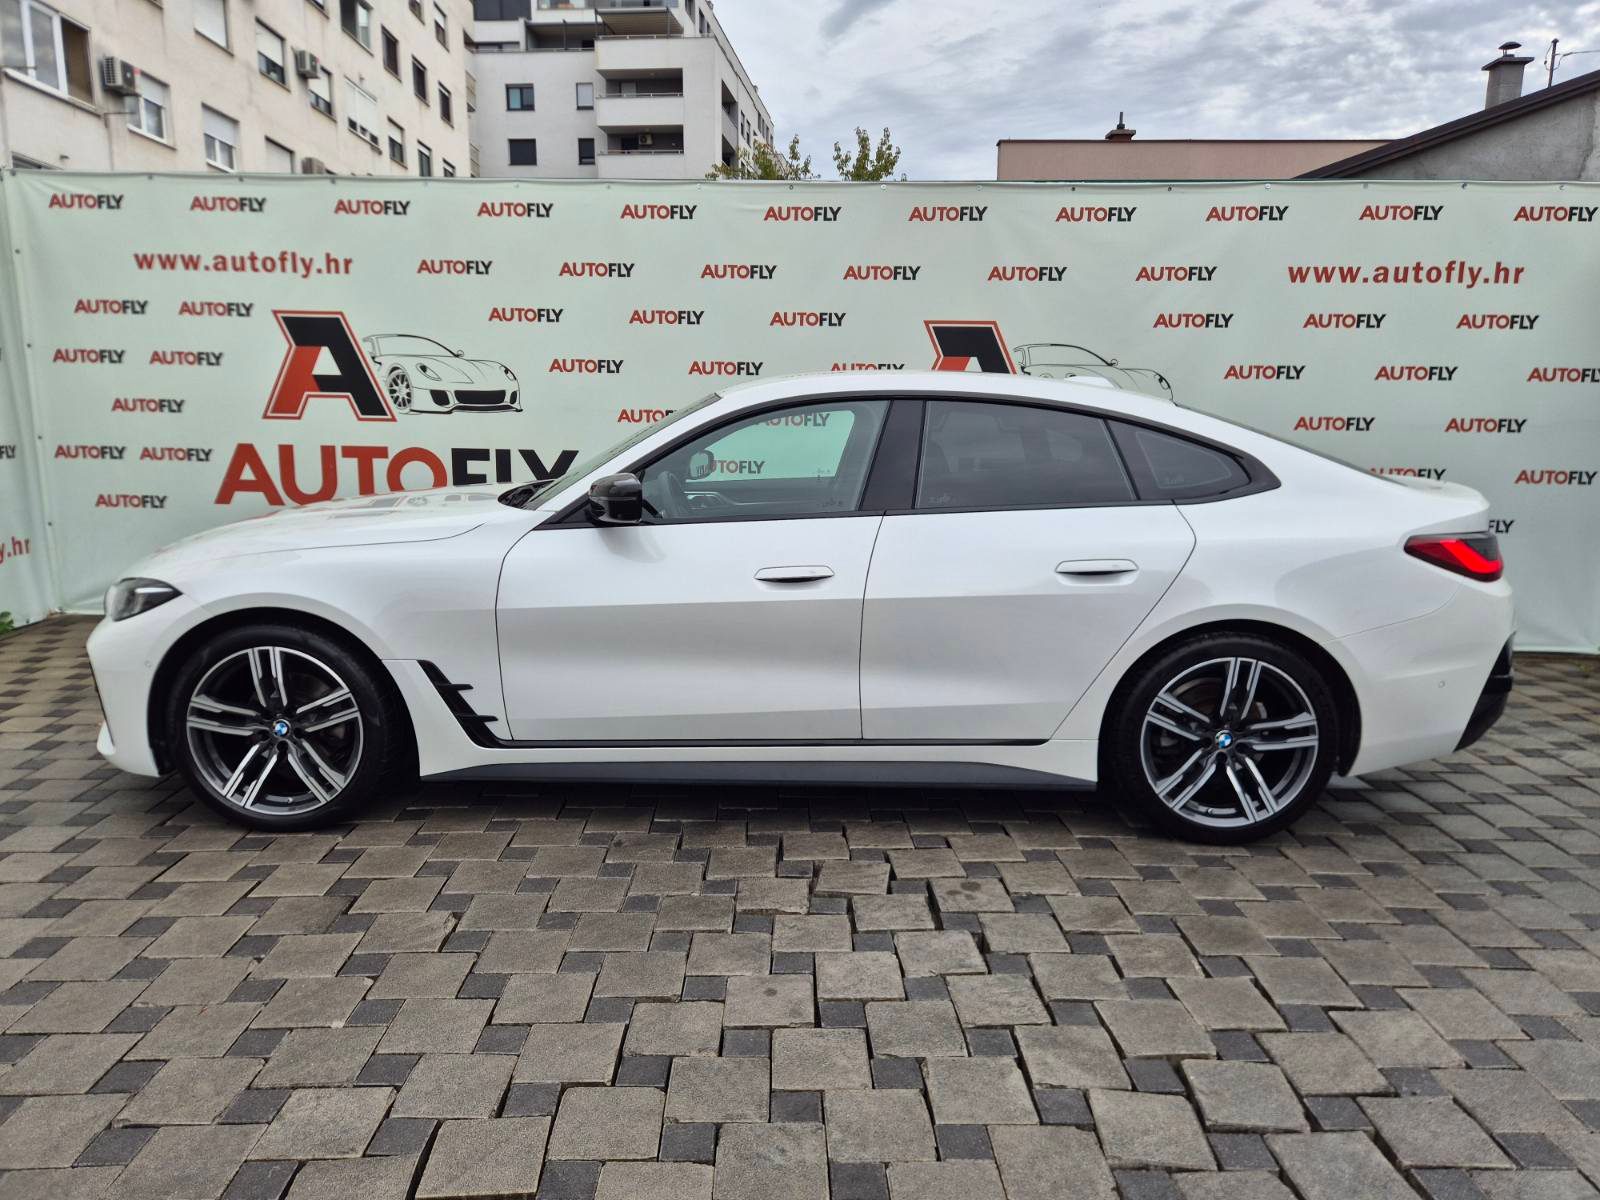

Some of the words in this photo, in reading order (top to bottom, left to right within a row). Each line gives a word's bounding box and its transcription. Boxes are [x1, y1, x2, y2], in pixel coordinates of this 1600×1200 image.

[49, 193, 124, 210] AUTOFLY
[190, 196, 266, 212] AUTOFLY
[334, 199, 410, 216] AUTOFLY
[477, 202, 554, 218] AUTOFLY
[620, 204, 697, 219] AUTOFLY
[764, 206, 842, 221] AUTOFLY
[908, 206, 988, 221] AUTOFLY
[1056, 207, 1137, 222] AUTOFLY
[1205, 206, 1289, 222] AUTOFLY
[1359, 205, 1444, 220] AUTOFLY
[1513, 206, 1599, 222] AUTOFLY
[133, 251, 352, 279] www.autofly.hr
[417, 259, 493, 275] AUTOFLY
[559, 262, 635, 277] AUTOFLY
[701, 264, 777, 279] AUTOFLY
[843, 265, 921, 280] AUTOFLY
[988, 266, 1067, 281] AUTOFLY
[1135, 266, 1218, 281] AUTOFLY
[1288, 260, 1525, 289] www.autofly.hr
[74, 299, 148, 315] AUTOFLY
[178, 301, 254, 317] AUTOFLY
[488, 307, 564, 323] AUTOFLY
[629, 310, 704, 325] AUTOFLY
[770, 312, 846, 327] AUTOFLY
[1153, 313, 1234, 328] AUTOFLY
[1303, 313, 1386, 328] AUTOFLY
[1456, 314, 1539, 330] AUTOFLY
[53, 349, 125, 364] AUTOFLY
[149, 351, 223, 366] AUTOFLY
[549, 359, 624, 373] AUTOFLY
[688, 361, 763, 376] AUTOFLY
[1224, 365, 1306, 380] AUTOFLY
[1374, 366, 1458, 381] AUTOFLY
[112, 398, 185, 413] AUTOFLY
[1294, 417, 1375, 431] AUTOFLY
[1445, 418, 1527, 433] AUTOFLY
[54, 445, 126, 459] AUTOFLY
[140, 447, 212, 462] AUTOFLY
[1514, 470, 1598, 485] AUTOFLY
[95, 494, 167, 508] AUTOFLY
